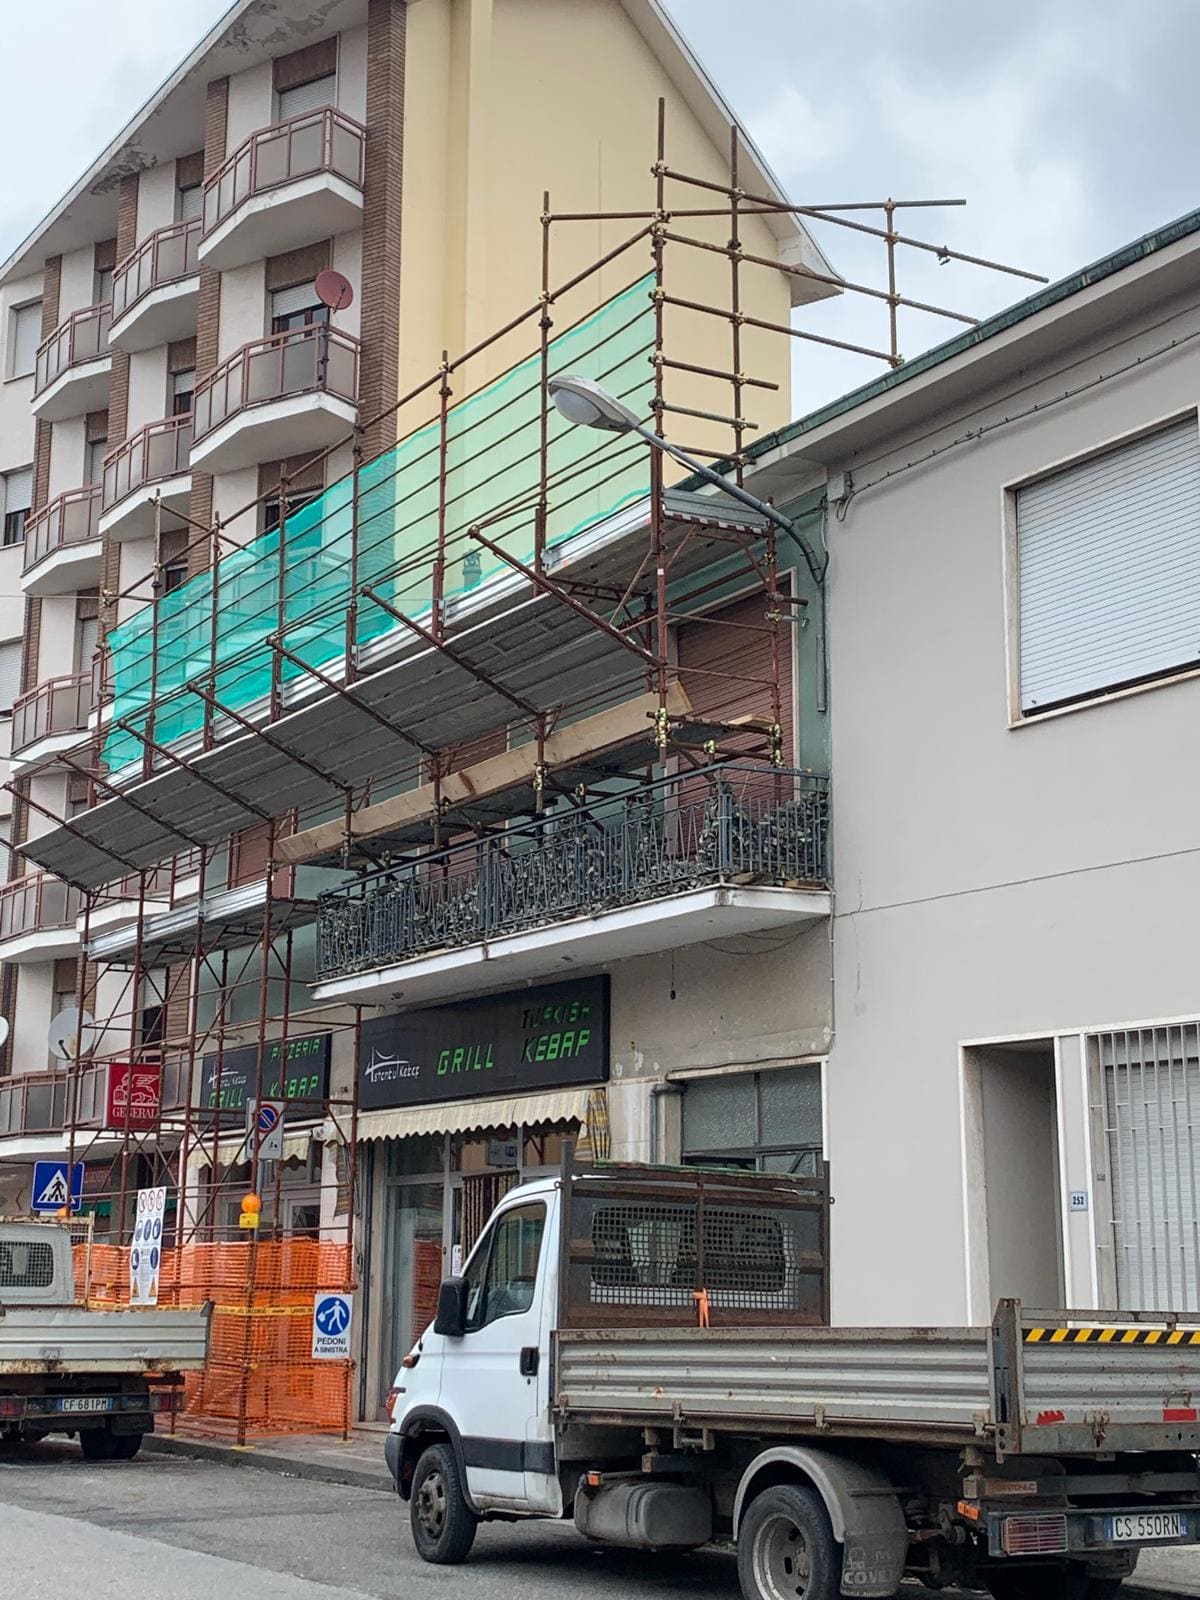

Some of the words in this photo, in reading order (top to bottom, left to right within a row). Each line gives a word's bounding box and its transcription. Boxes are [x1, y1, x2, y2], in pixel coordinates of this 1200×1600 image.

[271, 1038, 320, 1062] PIZERIA
[521, 1029, 591, 1063] KEBAP
[437, 1043, 494, 1076] GRILL
[269, 1075, 319, 1099] KBAP
[112, 1106, 159, 1119] GEERAL
[1072, 1195, 1084, 1206] 252
[313, 1346, 319, 1354] A
[320, 1345, 348, 1354] SINISTRA
[316, 1336, 346, 1346] PEDONI
[63, 1399, 75, 1412] CF
[1115, 1517, 1132, 1538] CS
[1138, 1514, 1179, 1537] 550RN
